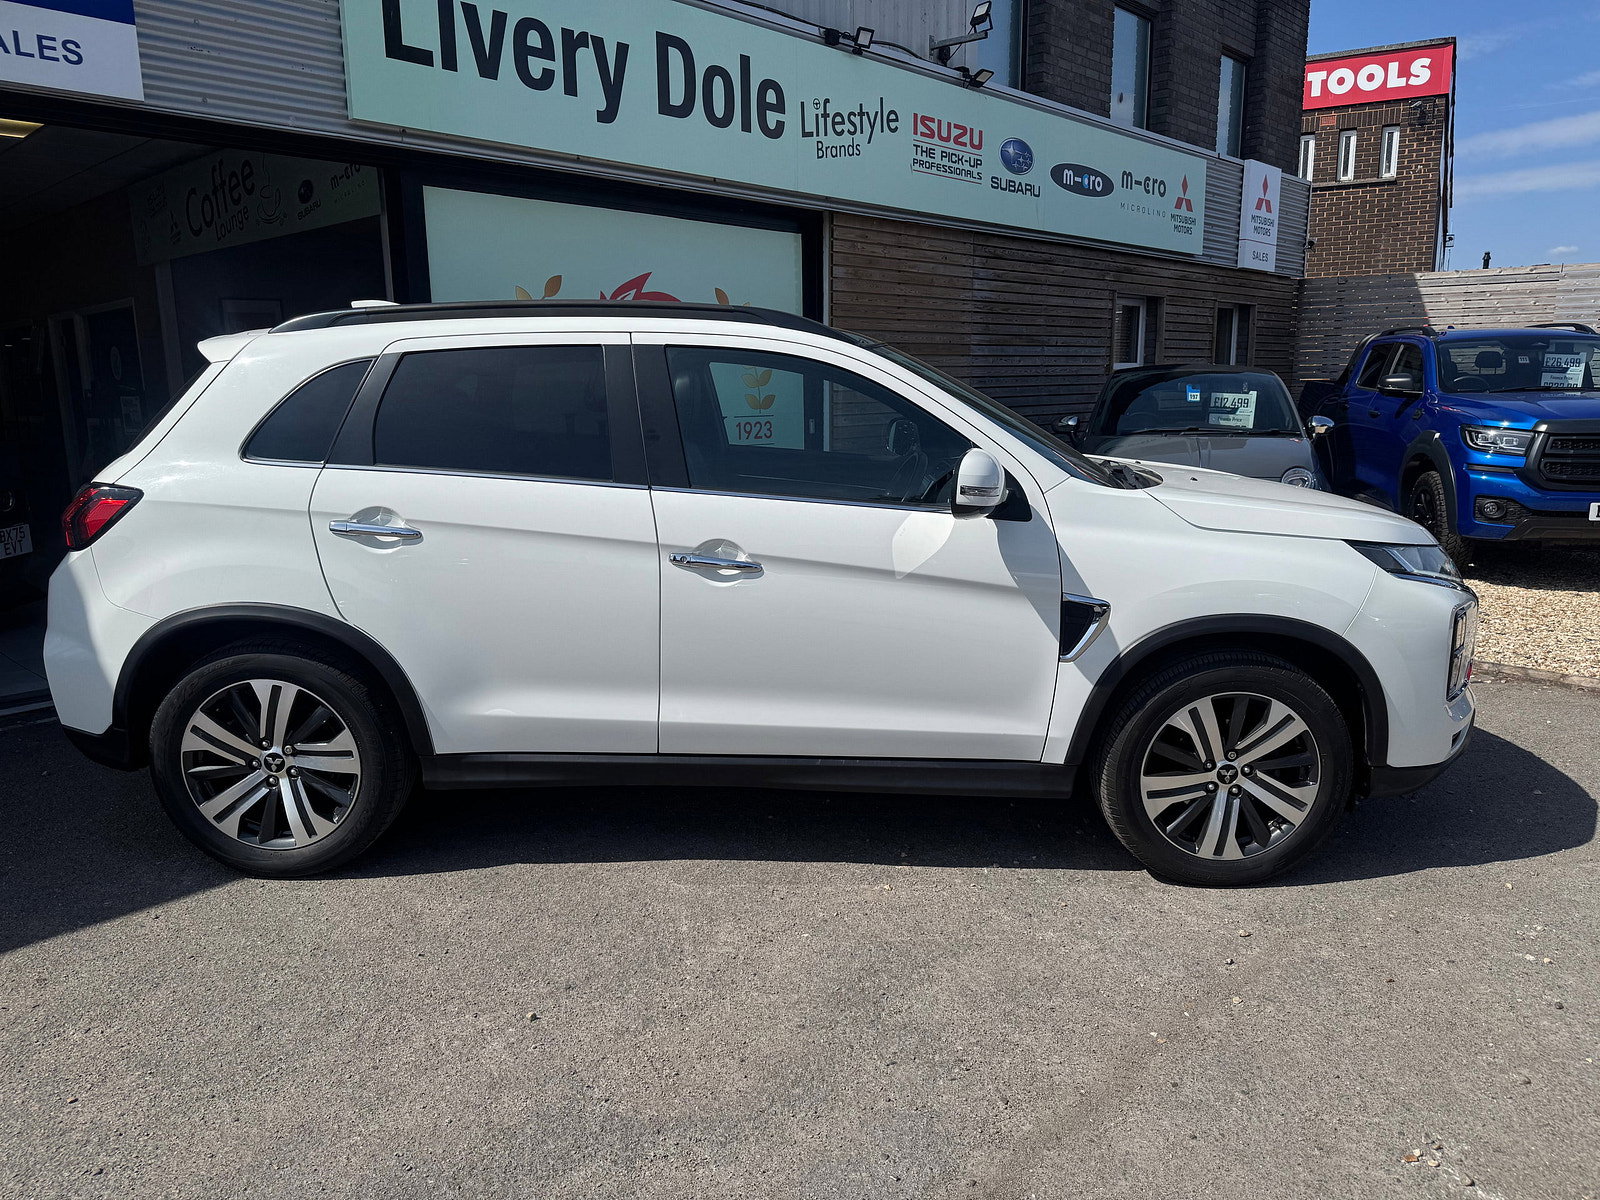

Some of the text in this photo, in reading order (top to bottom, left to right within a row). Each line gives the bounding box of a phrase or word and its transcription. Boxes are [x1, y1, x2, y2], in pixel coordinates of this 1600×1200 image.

[382, 0, 786, 139] Livery Dole
[1307, 57, 1432, 97] TOOLS
[800, 97, 899, 144] Lifestyle
[913, 113, 983, 150] ISUZU
[816, 138, 861, 159] Brands
[913, 144, 982, 169] THE PICK-UP
[913, 158, 982, 181] PROFESSIONALS
[186, 159, 256, 237] Coffee
[990, 176, 1041, 198] SUBARU
[297, 199, 322, 221] SUBARU
[1170, 213, 1197, 227] MITSUBISHI
[1251, 214, 1275, 228] MITSUBISHI
[214, 206, 249, 241] Lounge
[1173, 224, 1193, 236] MOTORS
[1253, 224, 1271, 237] MOTORS
[1252, 250, 1269, 263] SALES
[736, 420, 773, 440] 1923
[4, 540, 23, 555] EVT
